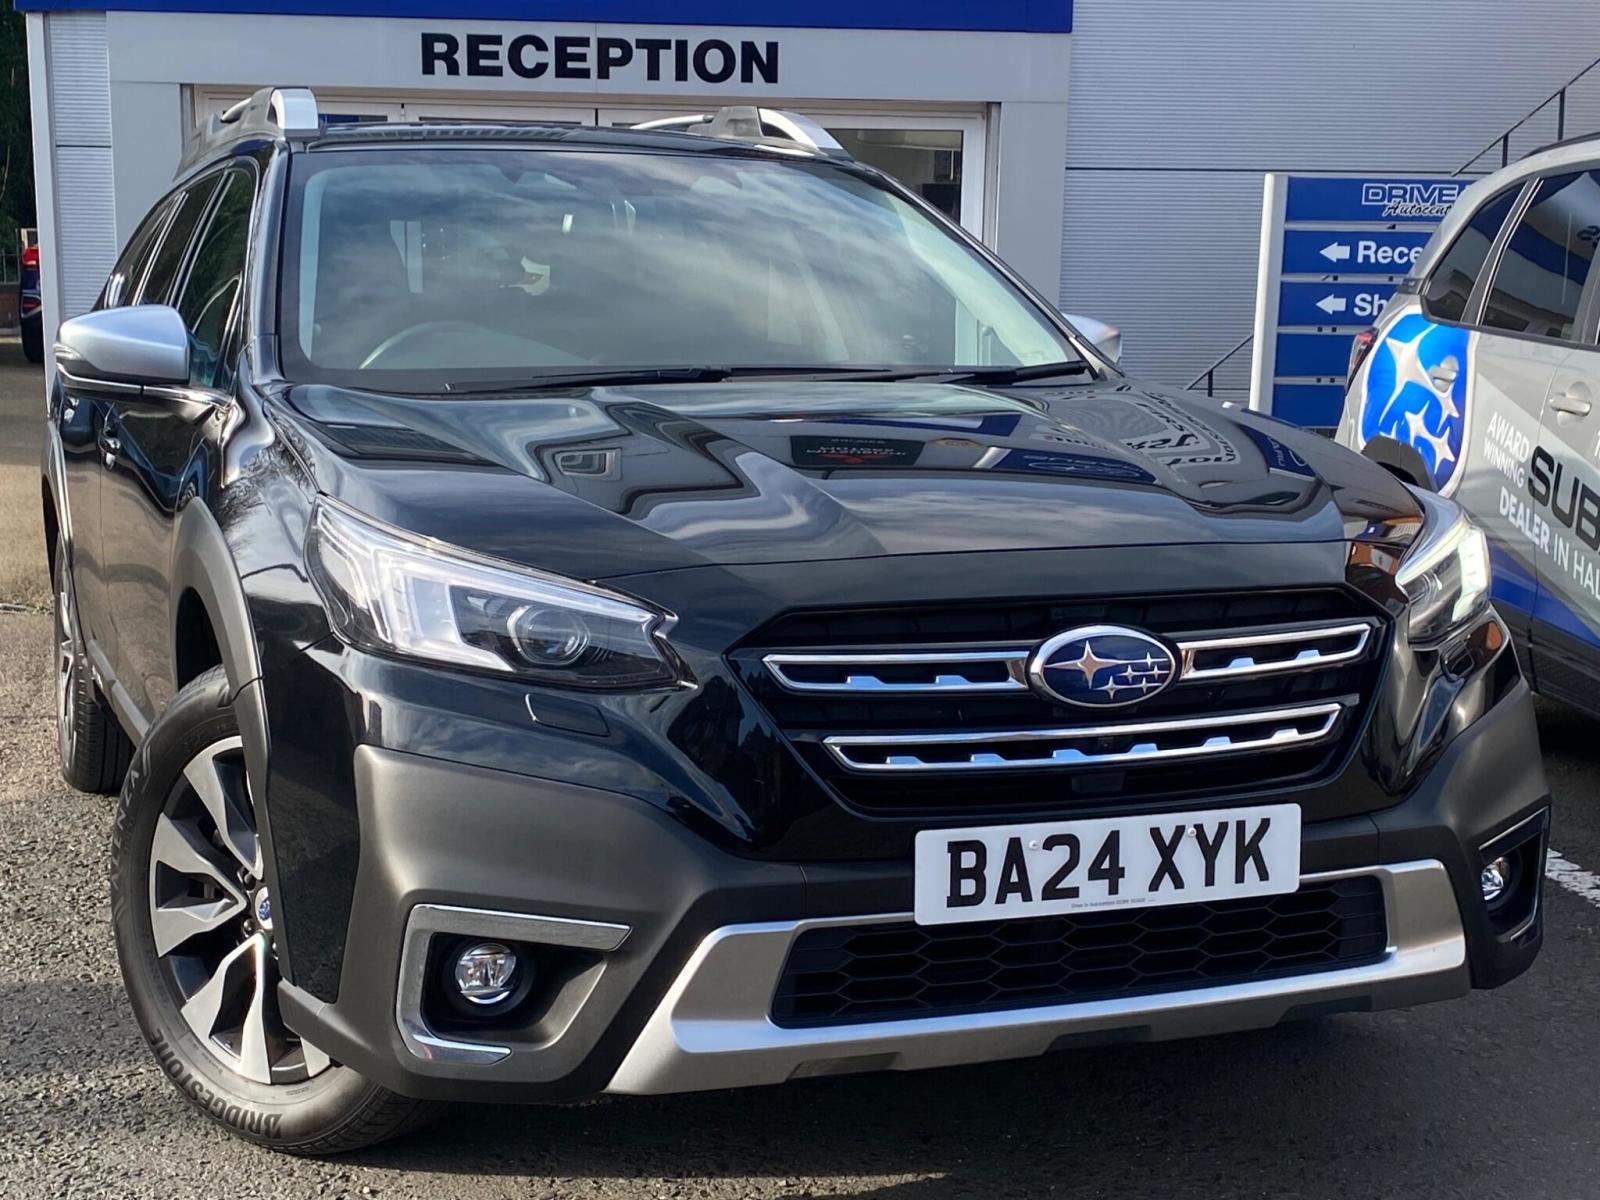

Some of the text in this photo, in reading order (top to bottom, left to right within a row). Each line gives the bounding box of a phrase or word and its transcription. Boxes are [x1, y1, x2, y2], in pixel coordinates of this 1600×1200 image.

[421, 32, 779, 84] RECEPTION
[1361, 183, 1459, 205] DRIVE
[1483, 437, 1525, 488] WINNING
[1487, 411, 1530, 462] AWARD
[1499, 486, 1550, 554] DEALER
[1553, 533, 1570, 572] IN
[946, 818, 1271, 908] BA24 XYK
[150, 1029, 282, 1139] BRIDGESTONE
